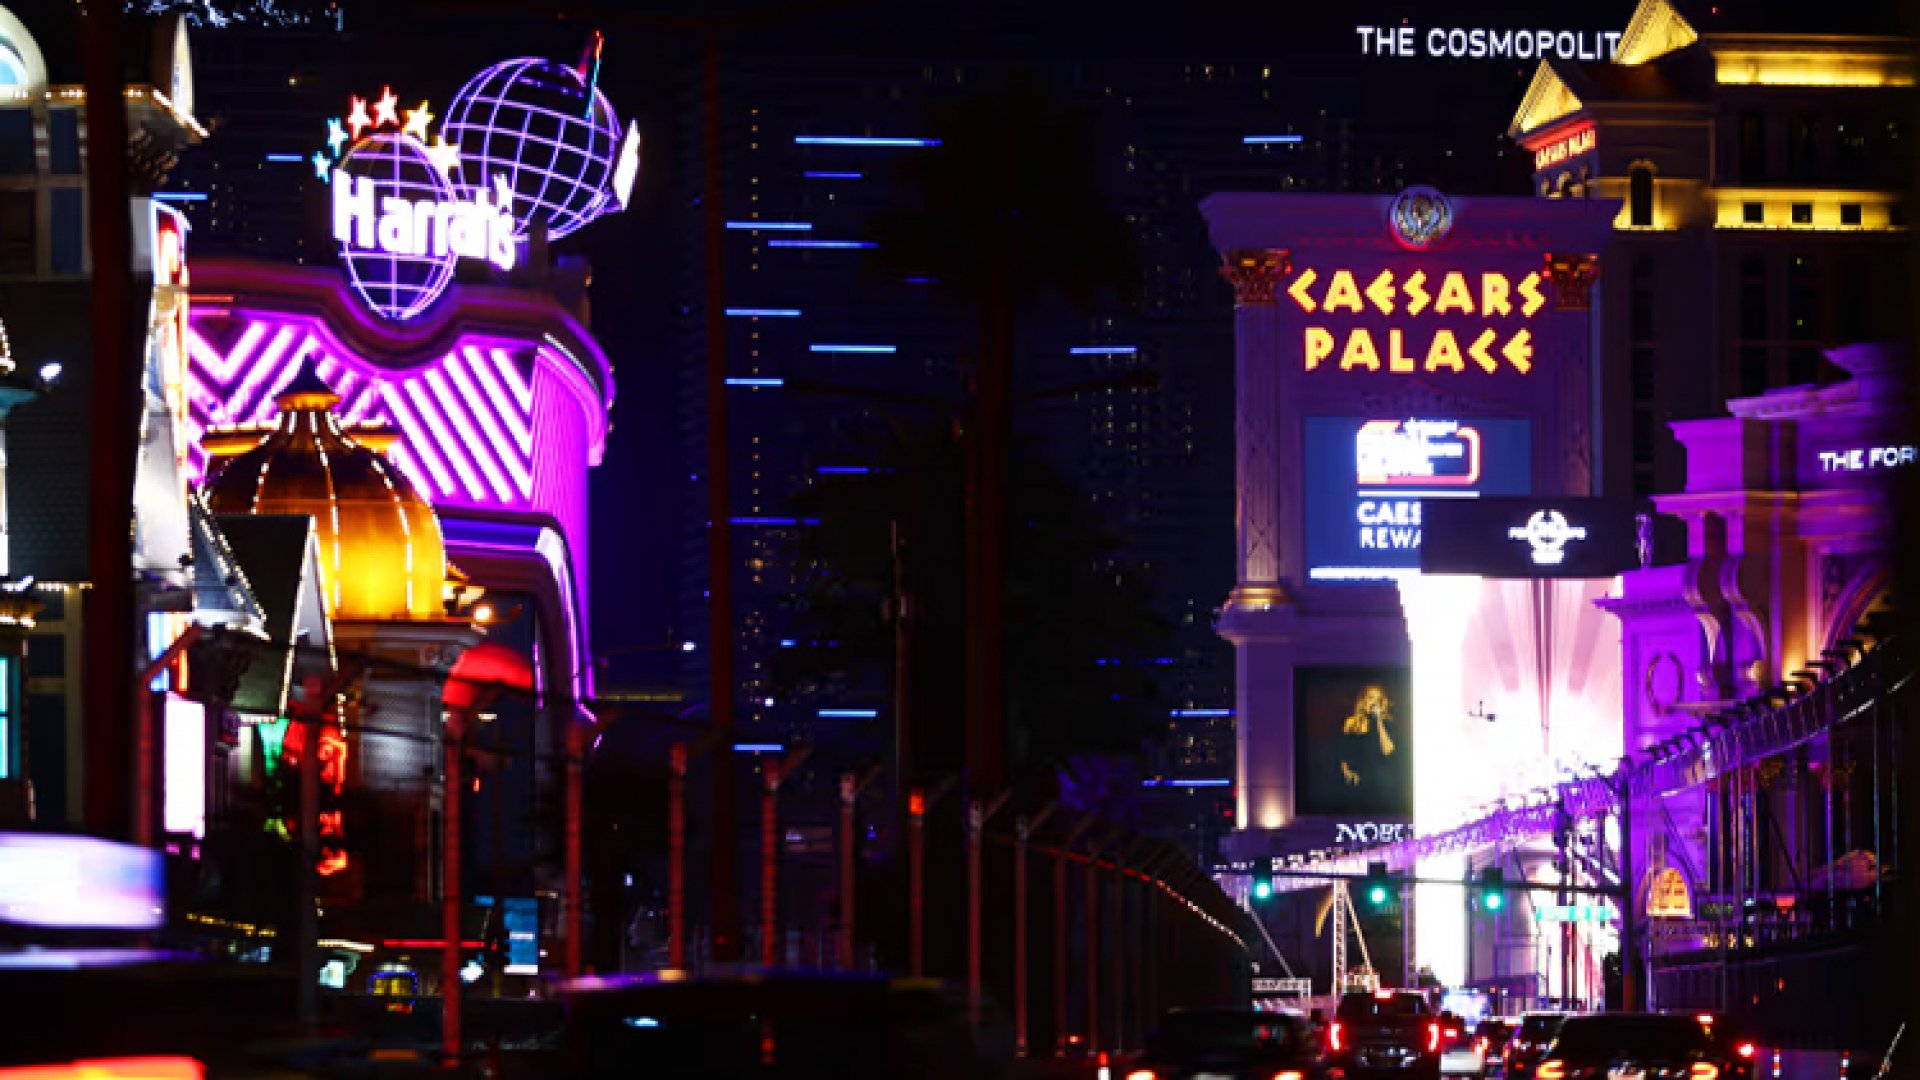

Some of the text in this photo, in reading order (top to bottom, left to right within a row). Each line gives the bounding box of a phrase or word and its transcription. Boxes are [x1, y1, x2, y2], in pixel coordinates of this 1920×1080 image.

[1356, 25, 1622, 60] THE COSMOPOLIT
[1288, 267, 1547, 317] CAESARS
[1304, 326, 1534, 375] PALACE
[1818, 449, 1864, 472] THE
